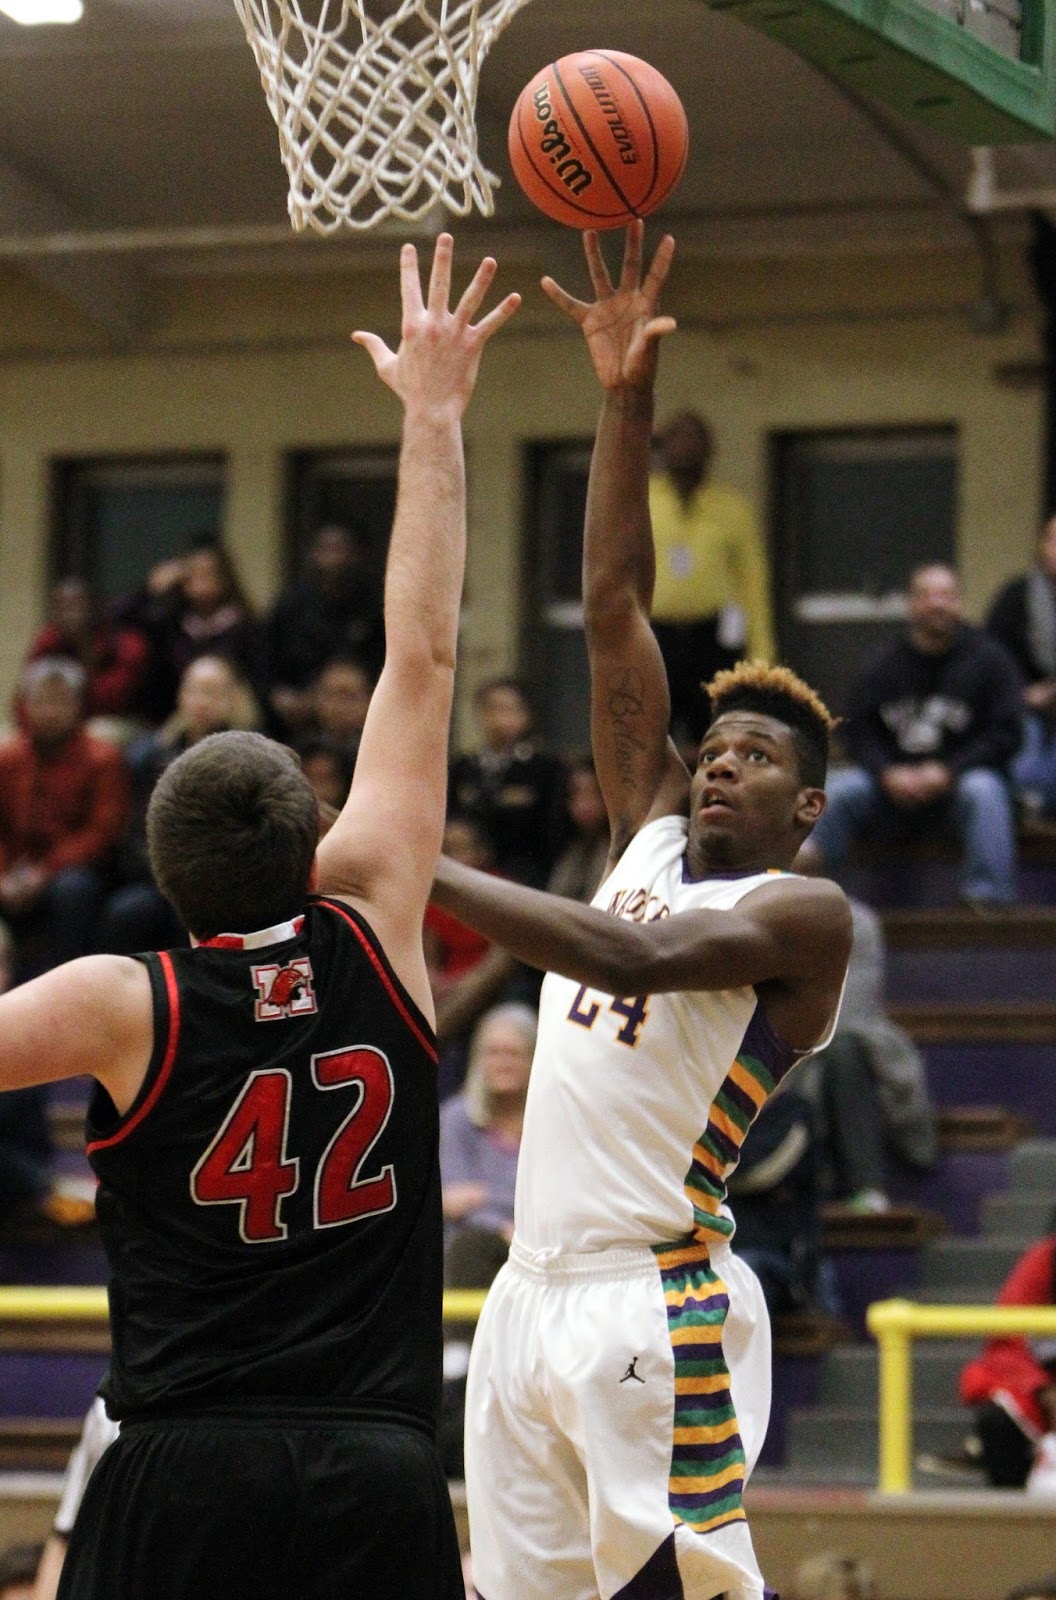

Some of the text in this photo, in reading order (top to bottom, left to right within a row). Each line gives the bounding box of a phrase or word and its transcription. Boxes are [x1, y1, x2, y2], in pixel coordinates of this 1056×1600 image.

[533, 81, 593, 197] Wilson
[579, 65, 636, 165] EVOLUTION
[564, 984, 651, 1050] 24
[190, 1044, 397, 1244] 42
